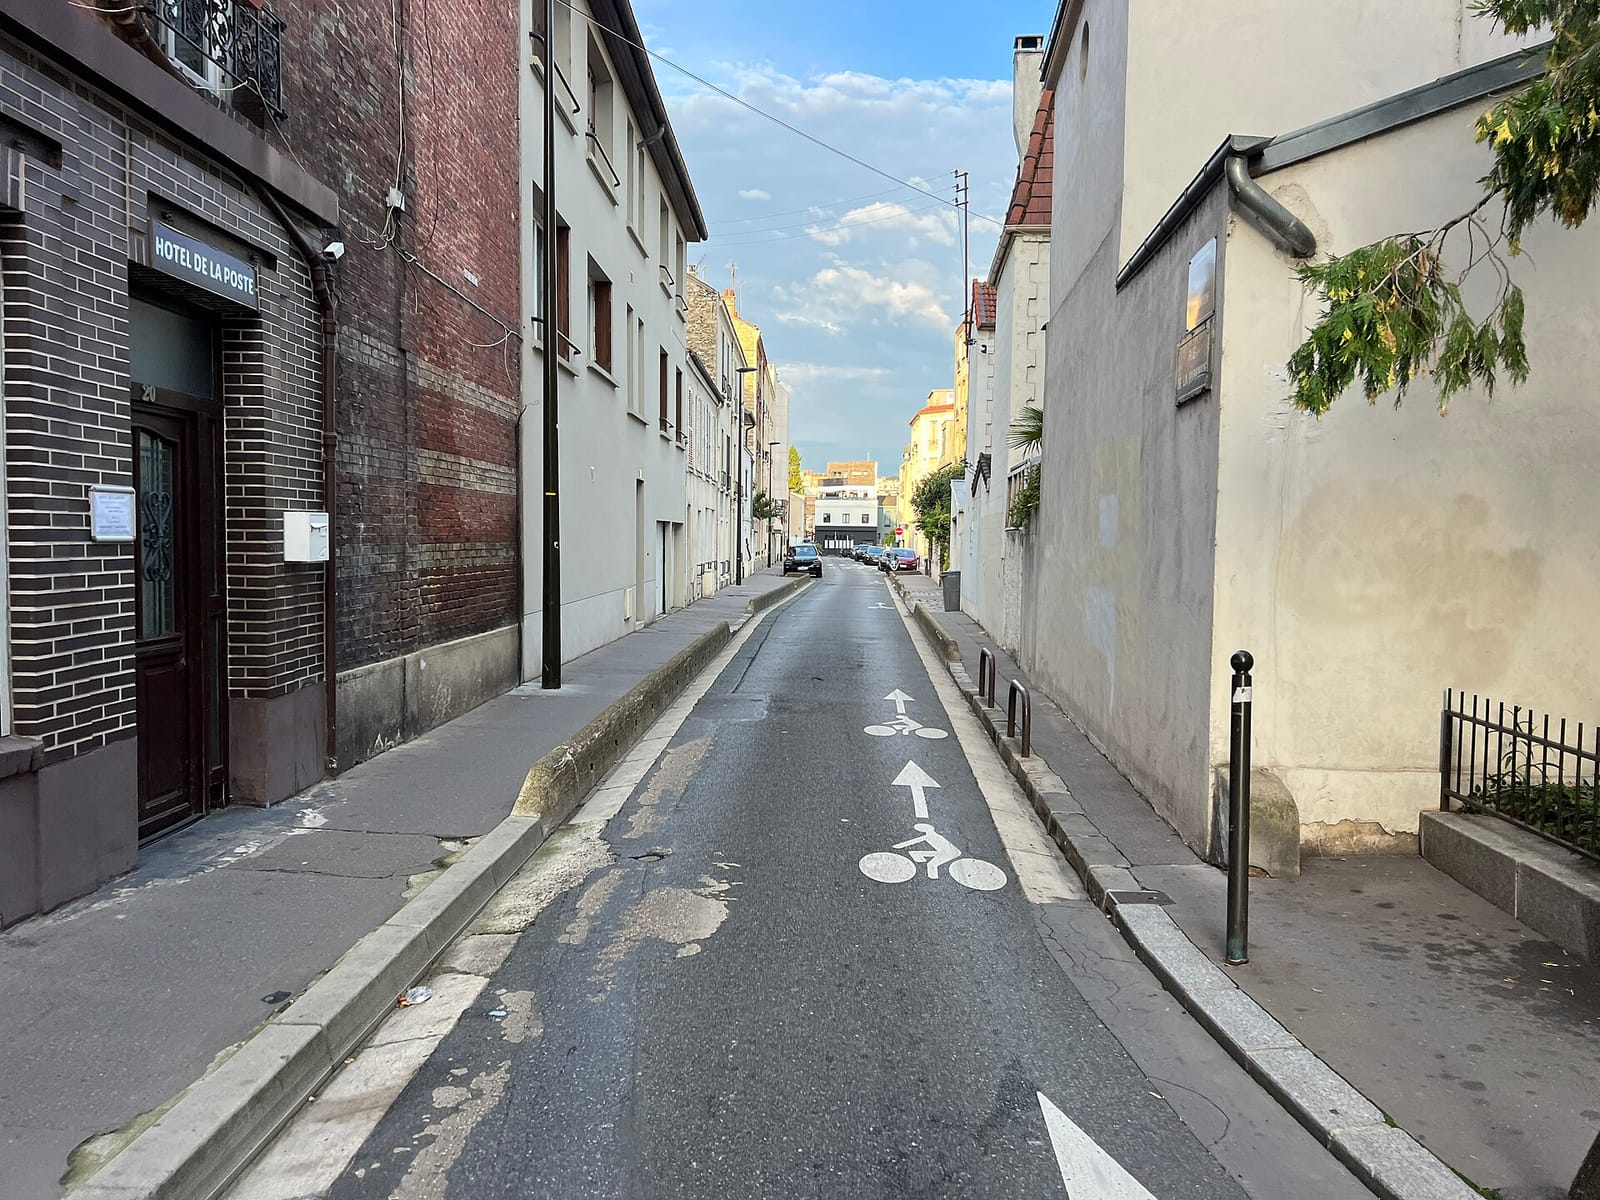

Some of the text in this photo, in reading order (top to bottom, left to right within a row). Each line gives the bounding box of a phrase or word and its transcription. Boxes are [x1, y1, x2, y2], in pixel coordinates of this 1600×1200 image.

[155, 235, 254, 295] HOTEL DE LA POSTE
[142, 384, 156, 402] 20
